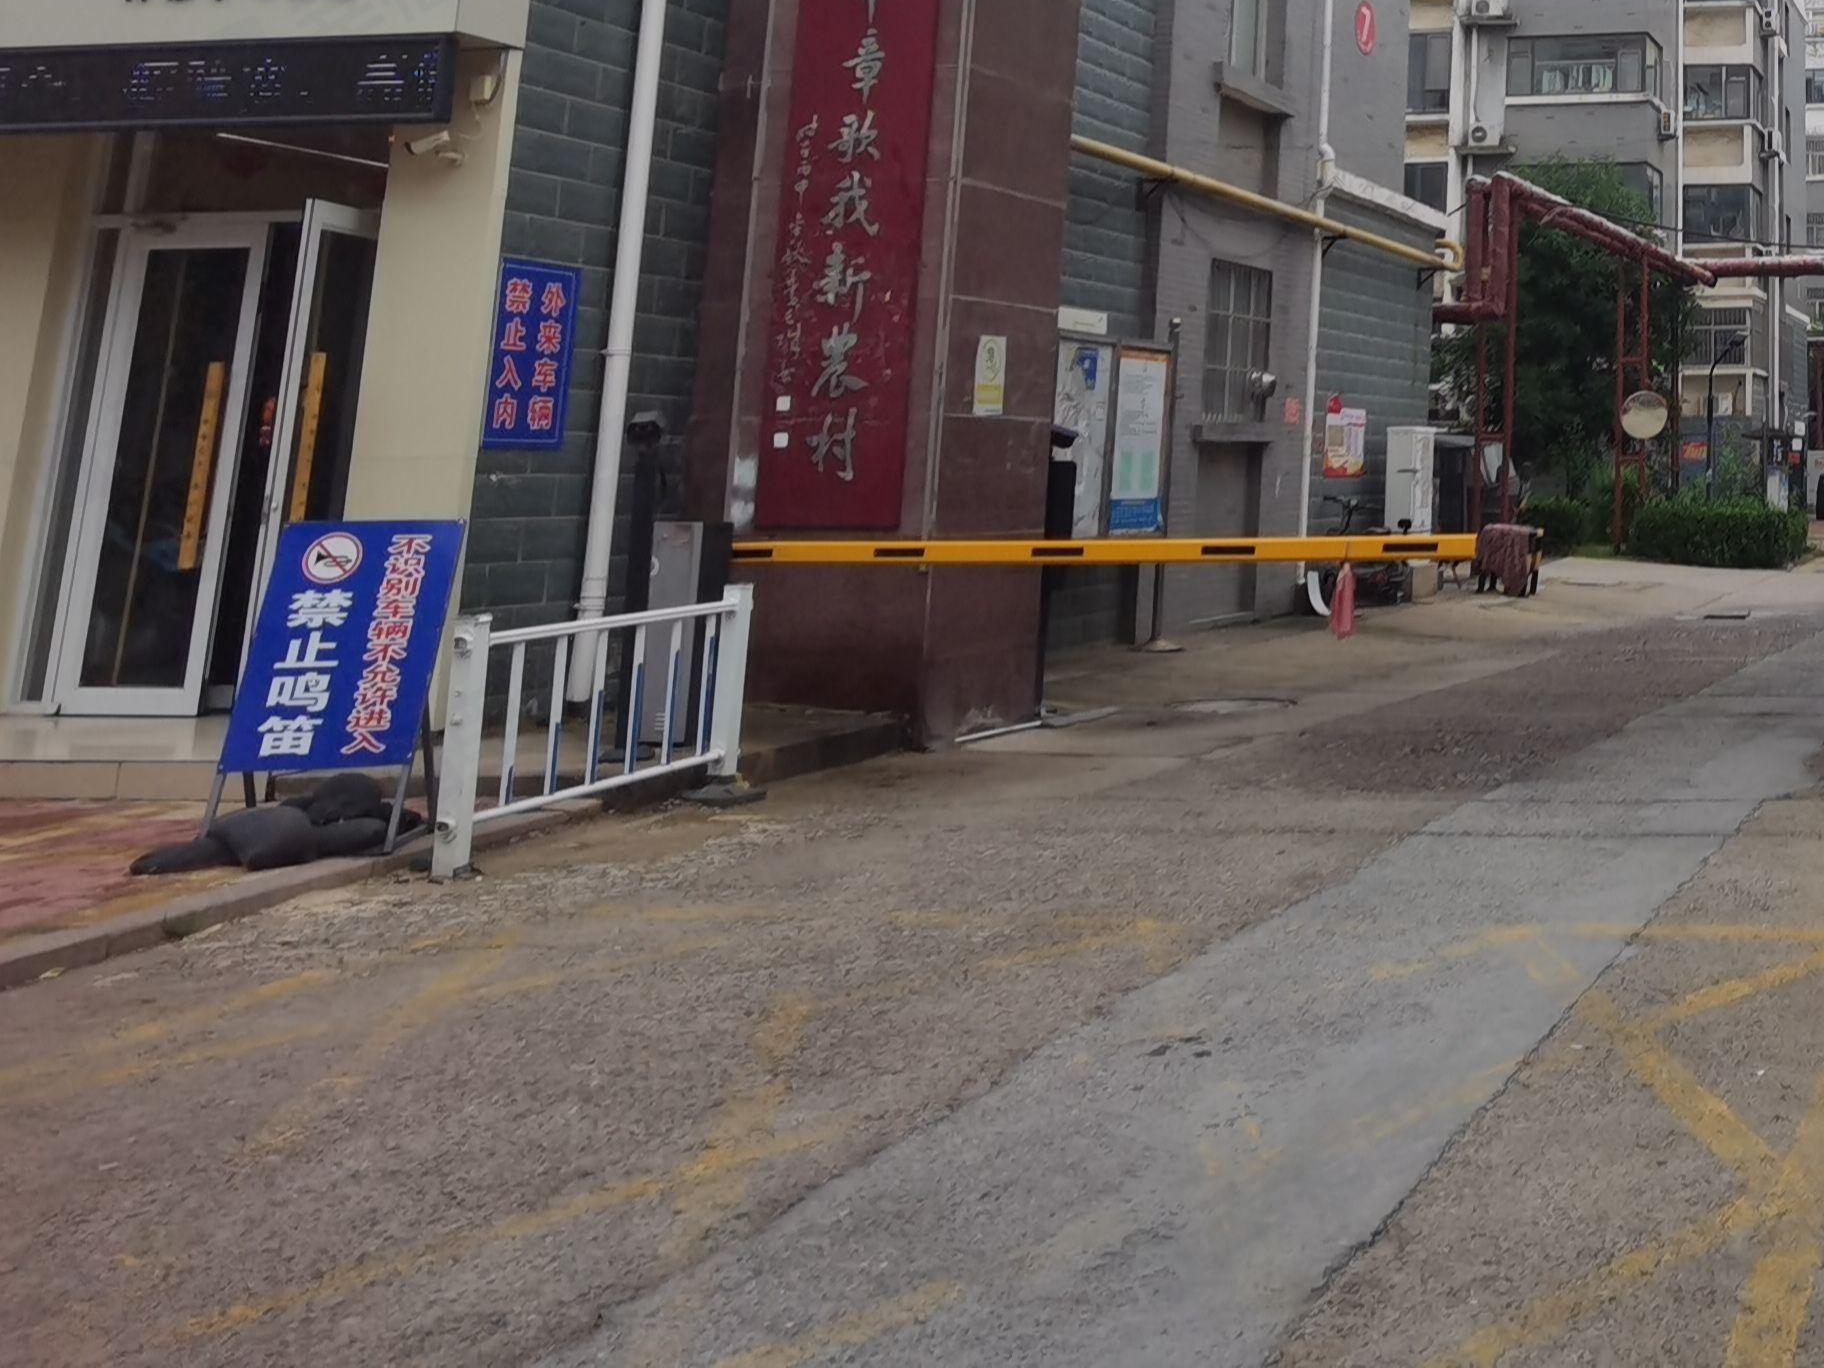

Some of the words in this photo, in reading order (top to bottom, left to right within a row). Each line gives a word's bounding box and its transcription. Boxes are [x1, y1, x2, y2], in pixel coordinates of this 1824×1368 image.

[493, 278, 533, 428] 禁止入内
[527, 283, 566, 429] 外来车辆
[256, 589, 354, 757] 禁止鸣笛
[341, 534, 432, 755] 不识别车辆不允许进入
